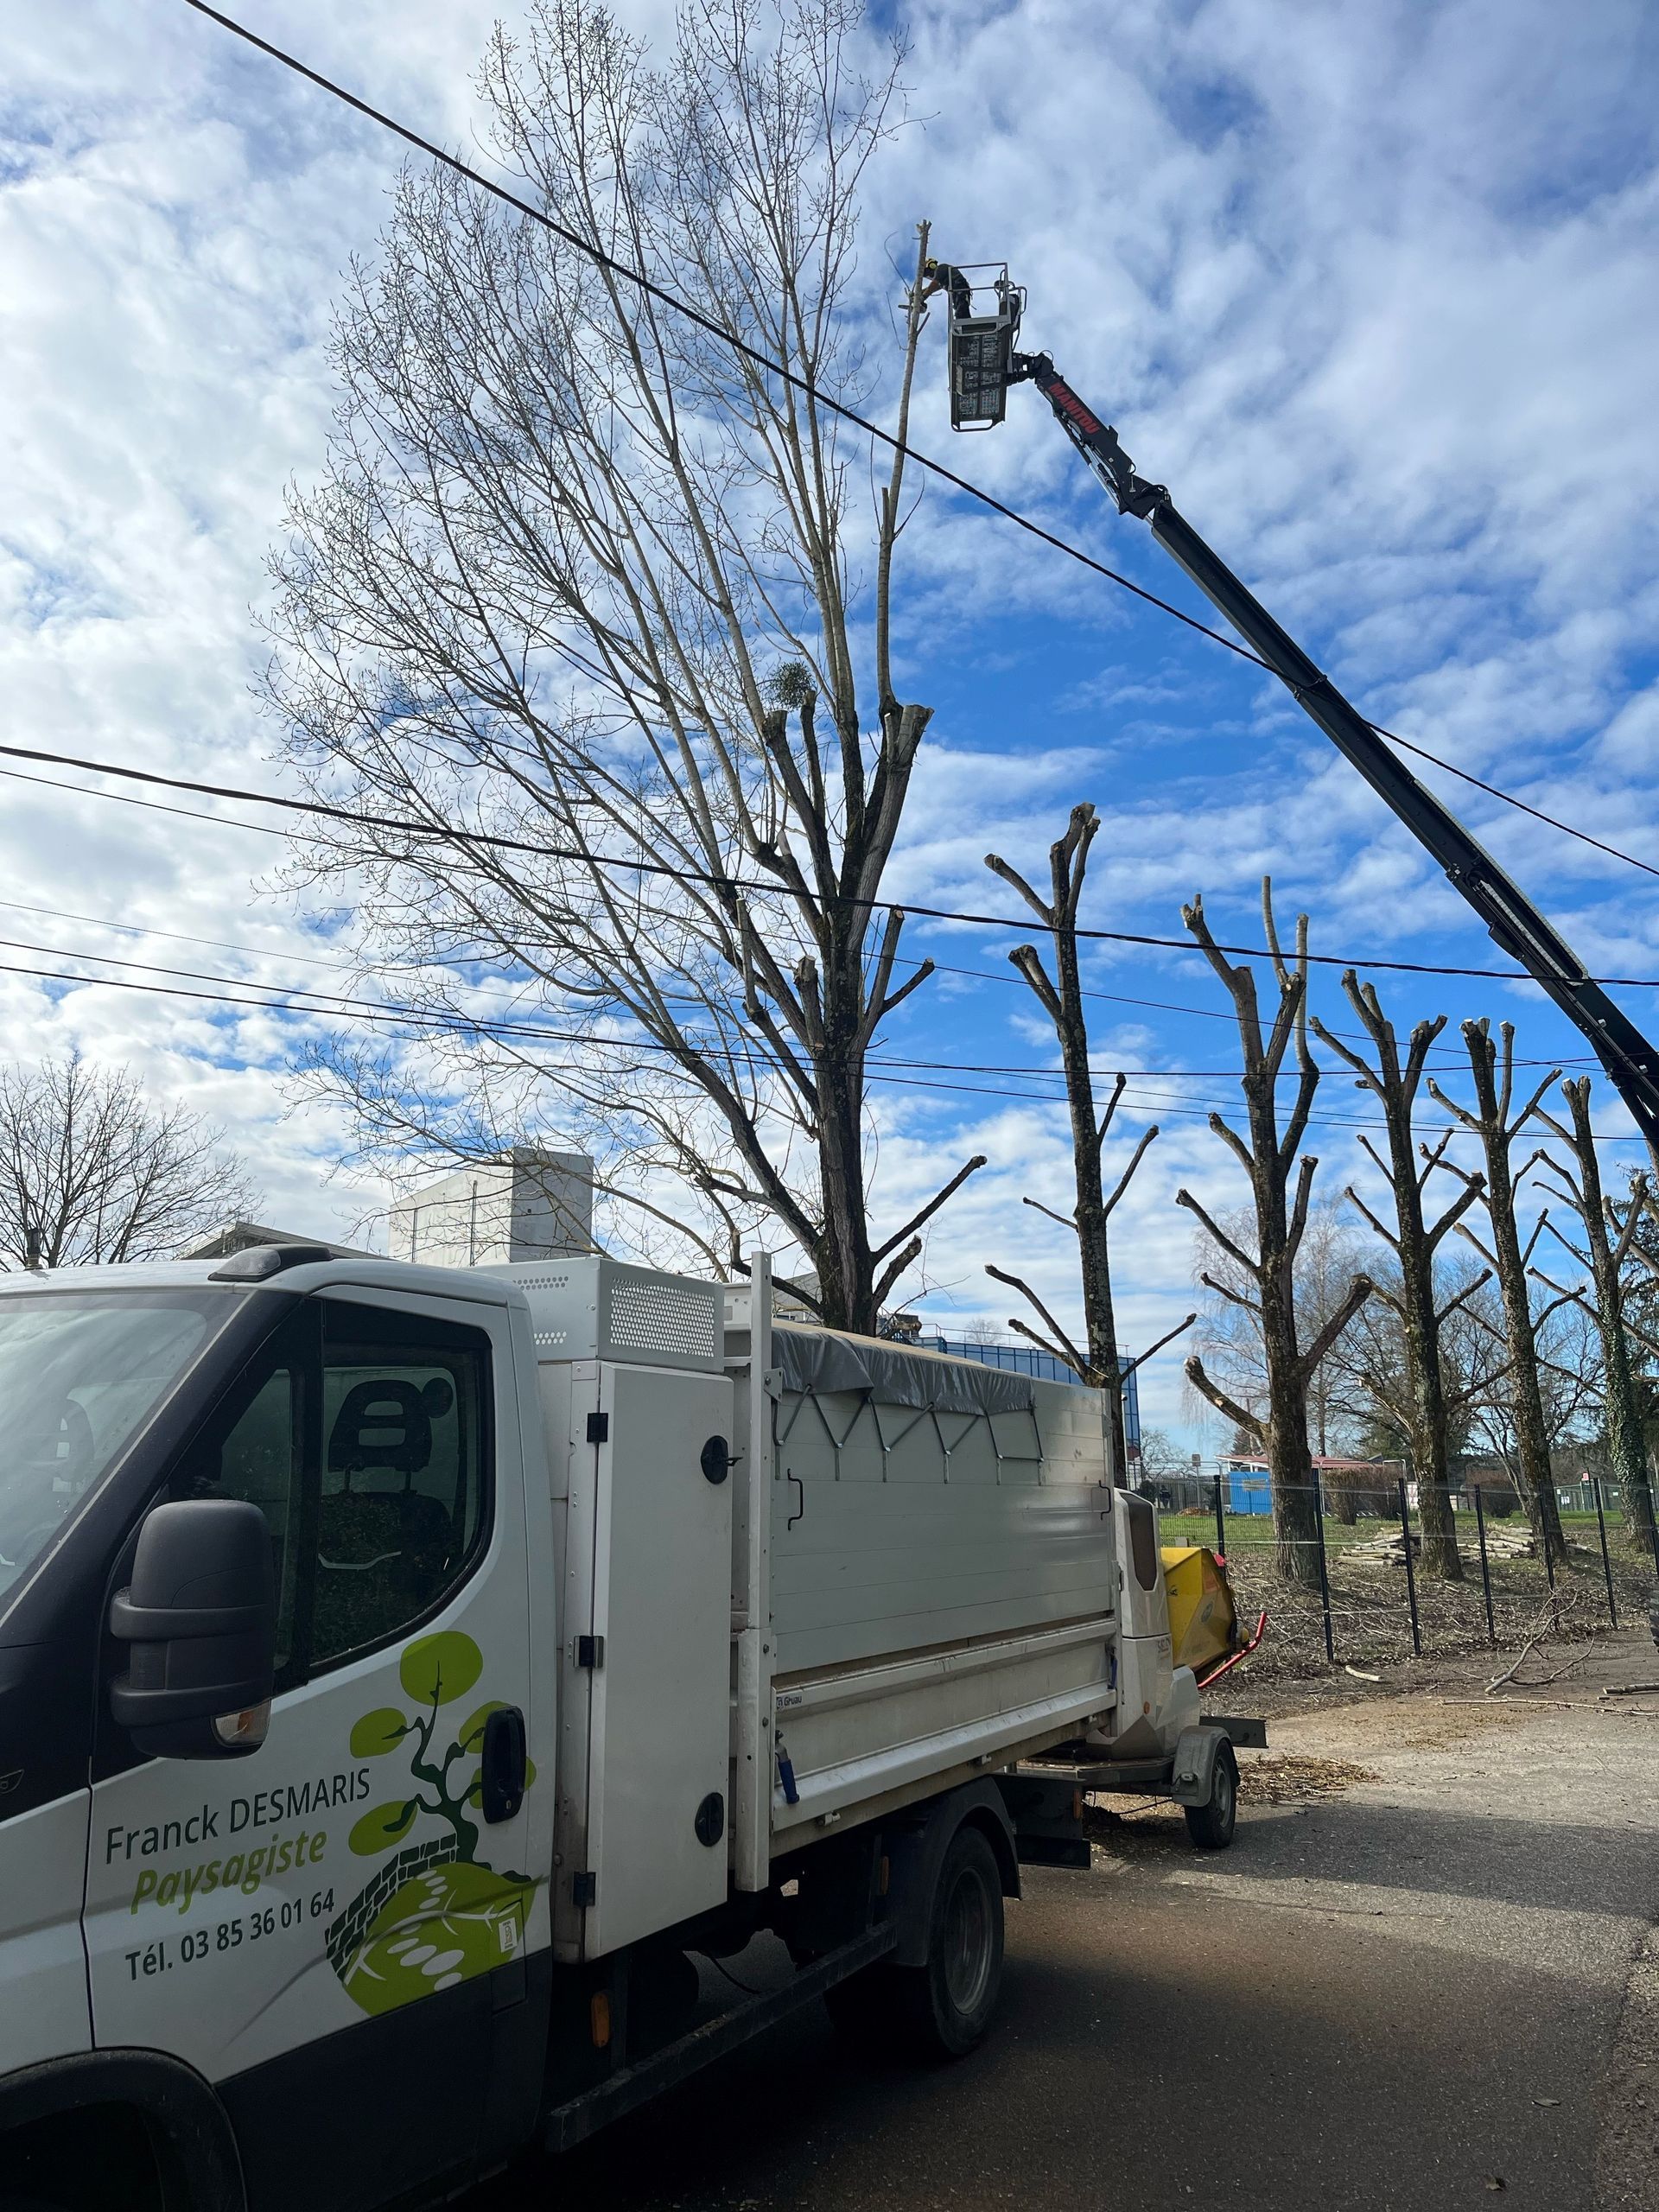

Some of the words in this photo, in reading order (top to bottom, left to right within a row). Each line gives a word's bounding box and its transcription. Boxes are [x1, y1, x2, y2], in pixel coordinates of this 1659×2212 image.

[1050, 382, 1100, 434] MANITOU
[106, 1804, 219, 1864] Franck
[230, 1768, 371, 1834] DESMARIS
[130, 1830, 327, 1916] Paysagiste
[125, 1942, 173, 1981] Tél.
[181, 1930, 208, 1964] 03
[216, 1917, 244, 1952] 85
[250, 1908, 276, 1942] 36
[281, 1897, 303, 1929] 01
[309, 1887, 335, 1919] 64
